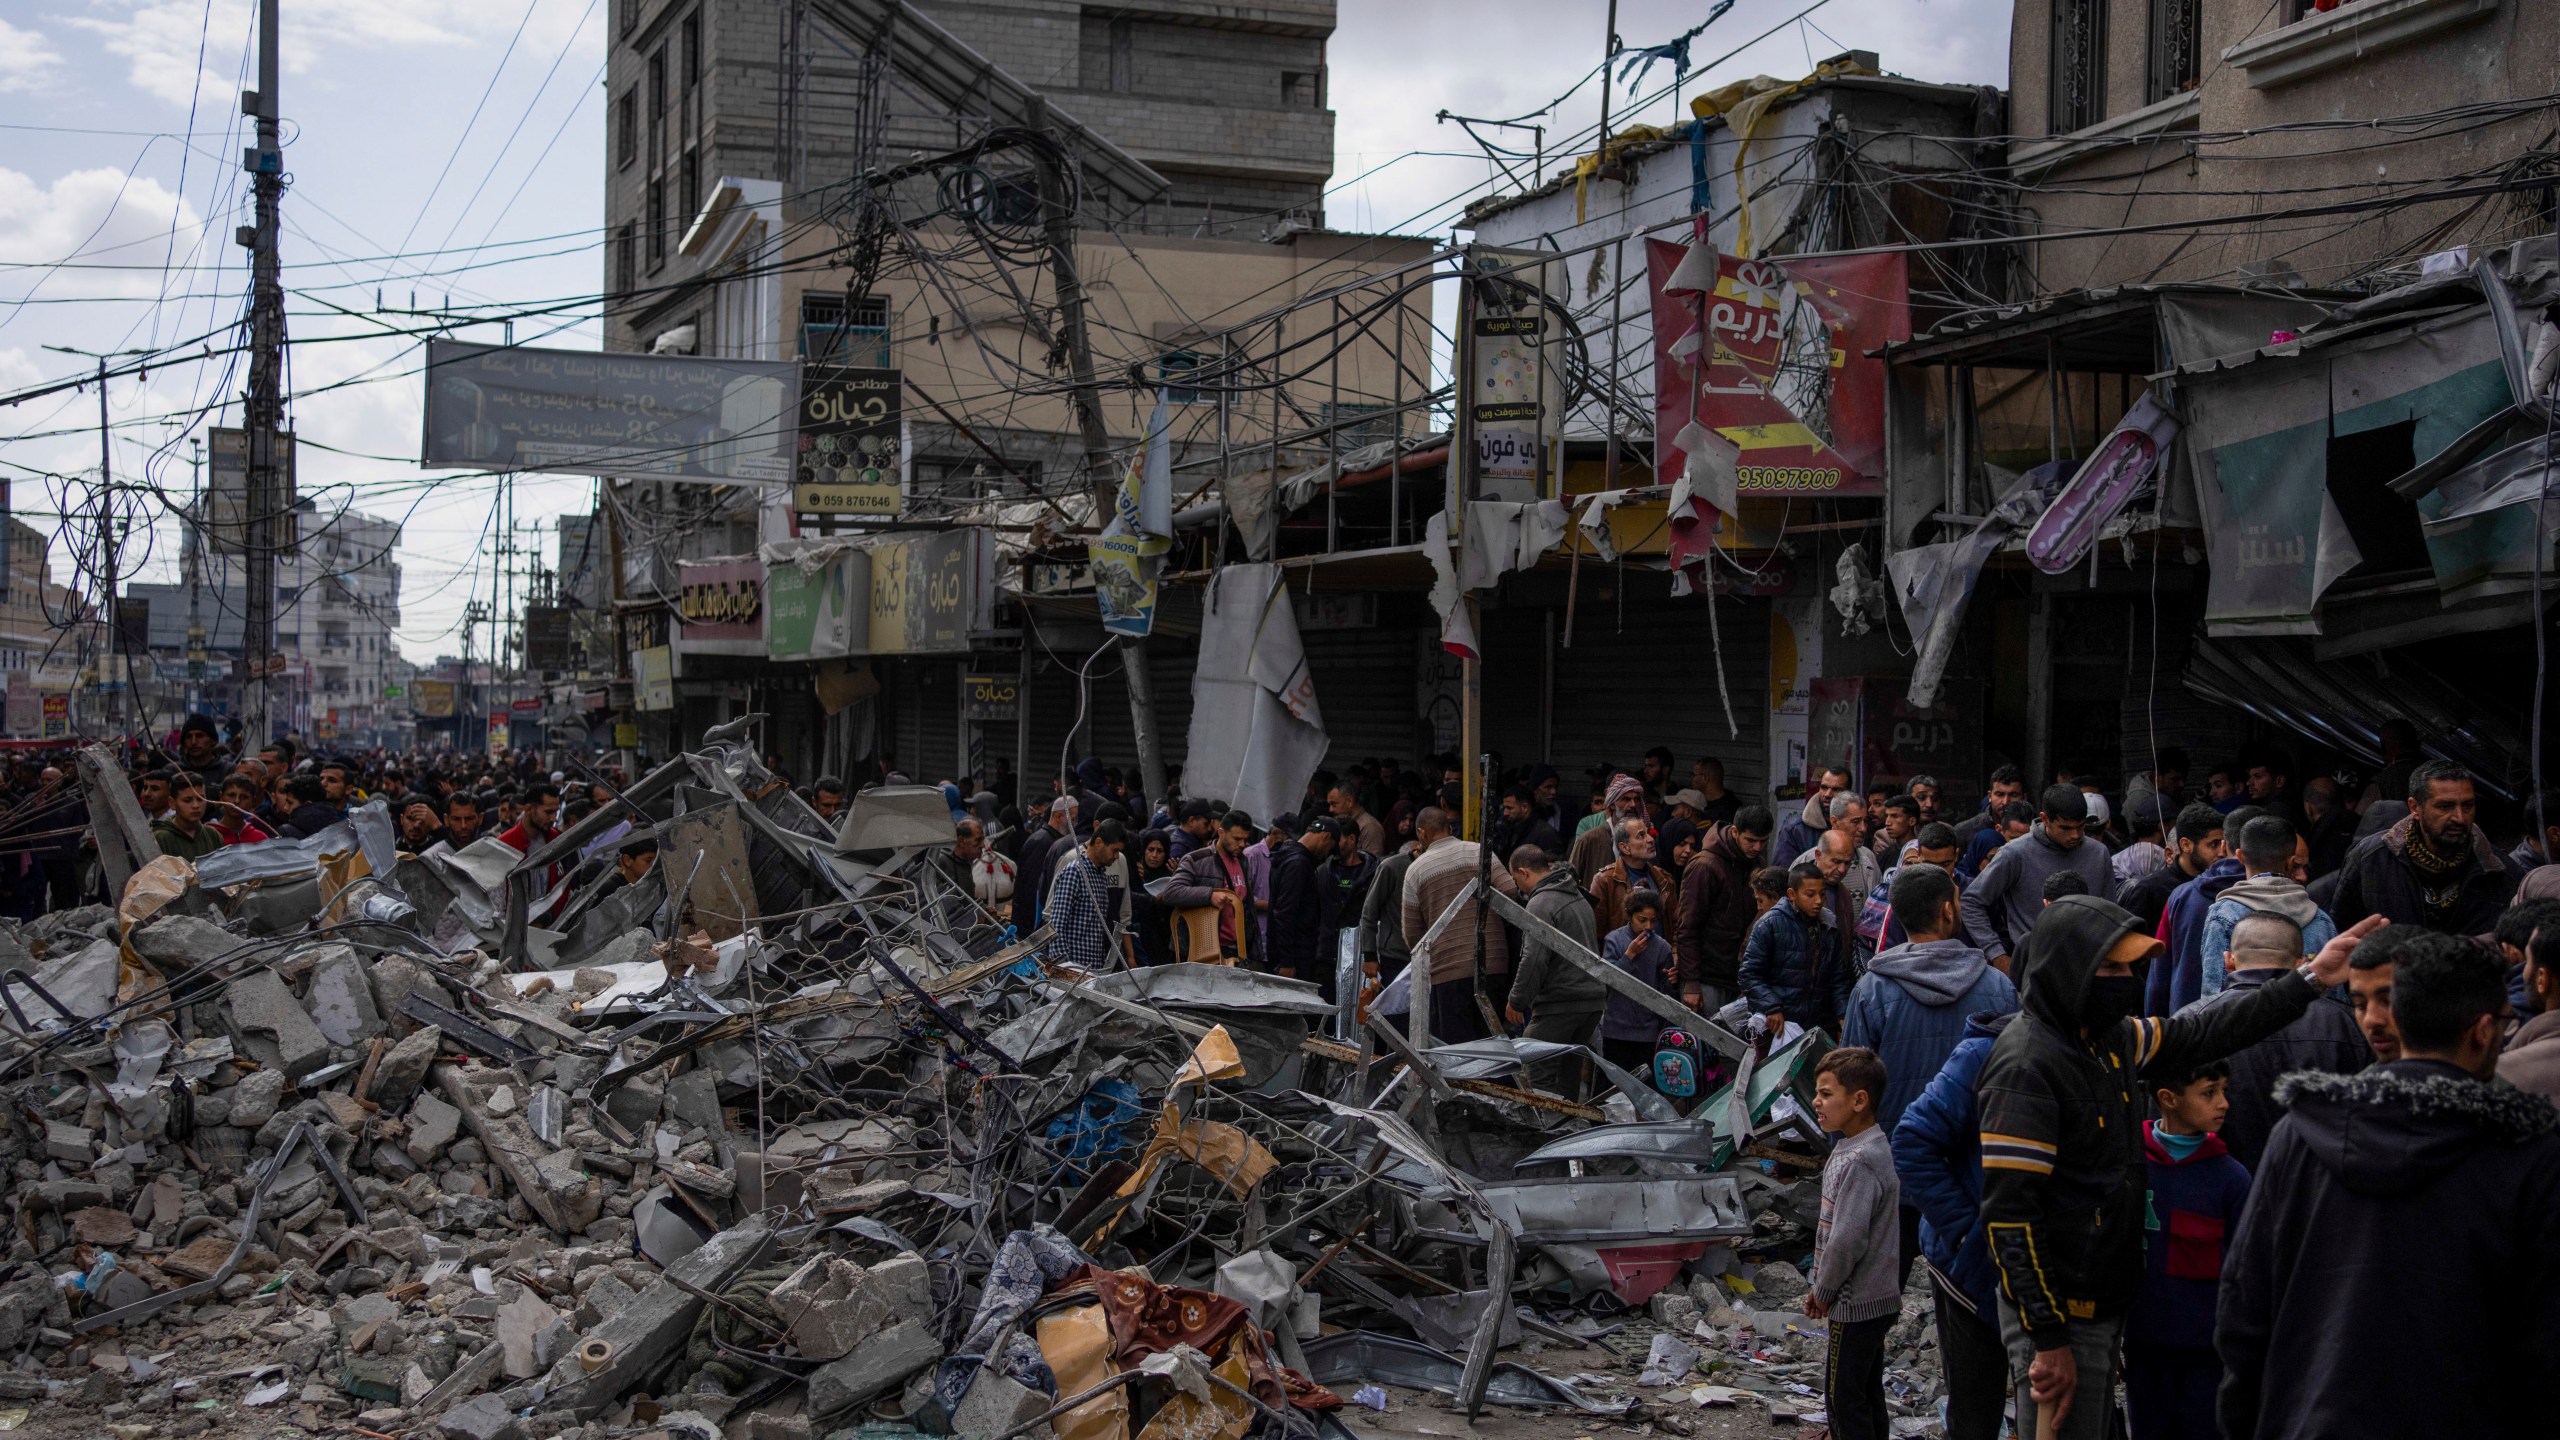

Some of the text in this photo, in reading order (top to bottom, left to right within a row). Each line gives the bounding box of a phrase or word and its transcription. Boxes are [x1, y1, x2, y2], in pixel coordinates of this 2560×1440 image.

[1487, 320, 1510, 332] فورية
[1710, 303, 1783, 344] دريم
[846, 378, 888, 391] مطاحن
[809, 391, 888, 426] جبارة
[1481, 434, 1514, 464] فون
[1736, 466, 1842, 490] 95097900
[824, 496, 890, 507] 059 8767646
[1088, 538, 1138, 555] 9916009
[874, 577, 900, 620] جبارة
[930, 568, 960, 614] جبارة
[976, 685, 1016, 704] جبارة
[1890, 721, 1953, 752] دريم
